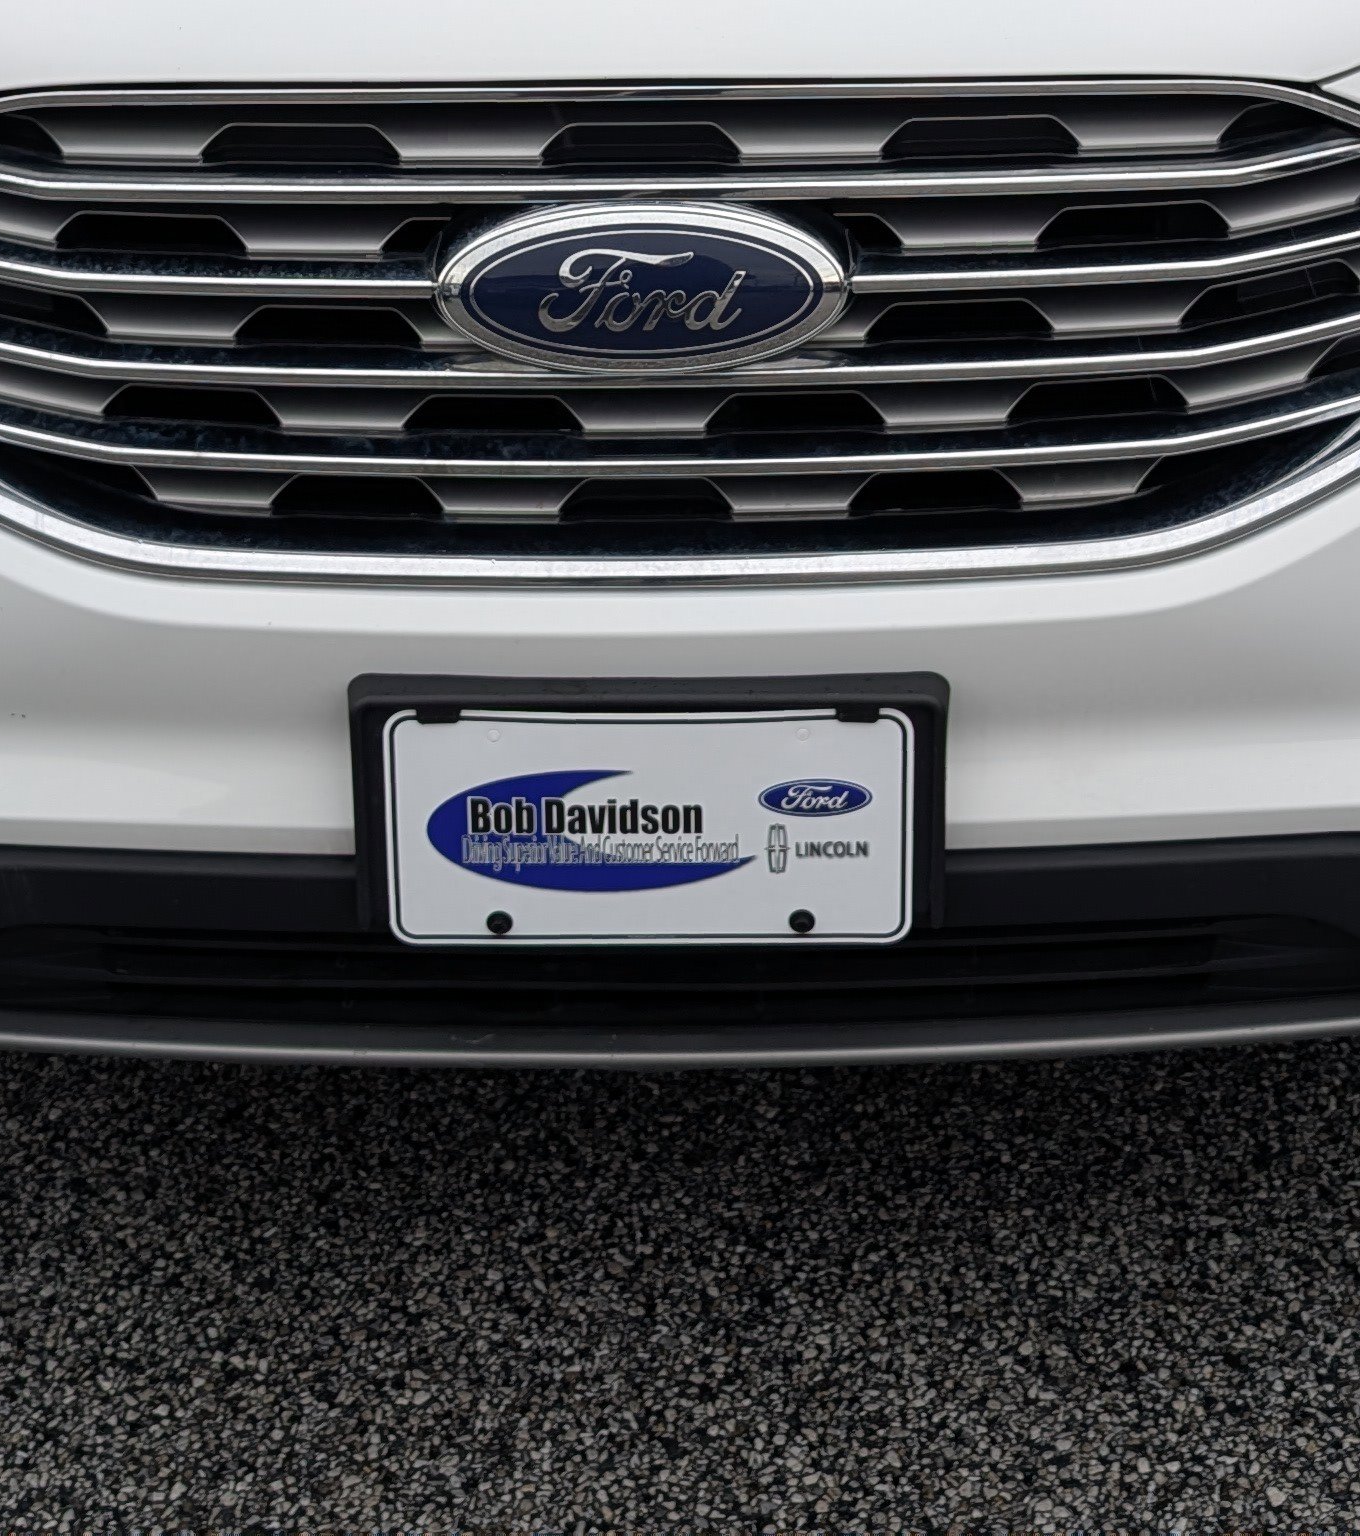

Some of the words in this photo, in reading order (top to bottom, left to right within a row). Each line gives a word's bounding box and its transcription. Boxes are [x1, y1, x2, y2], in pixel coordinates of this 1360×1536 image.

[537, 247, 747, 333] Ford
[780, 784, 850, 810] Ford
[469, 797, 535, 834] Bob
[543, 797, 704, 835] Davidson
[655, 835, 694, 863] Service
[694, 833, 739, 863] Forward
[794, 841, 870, 859] LINCOLN
